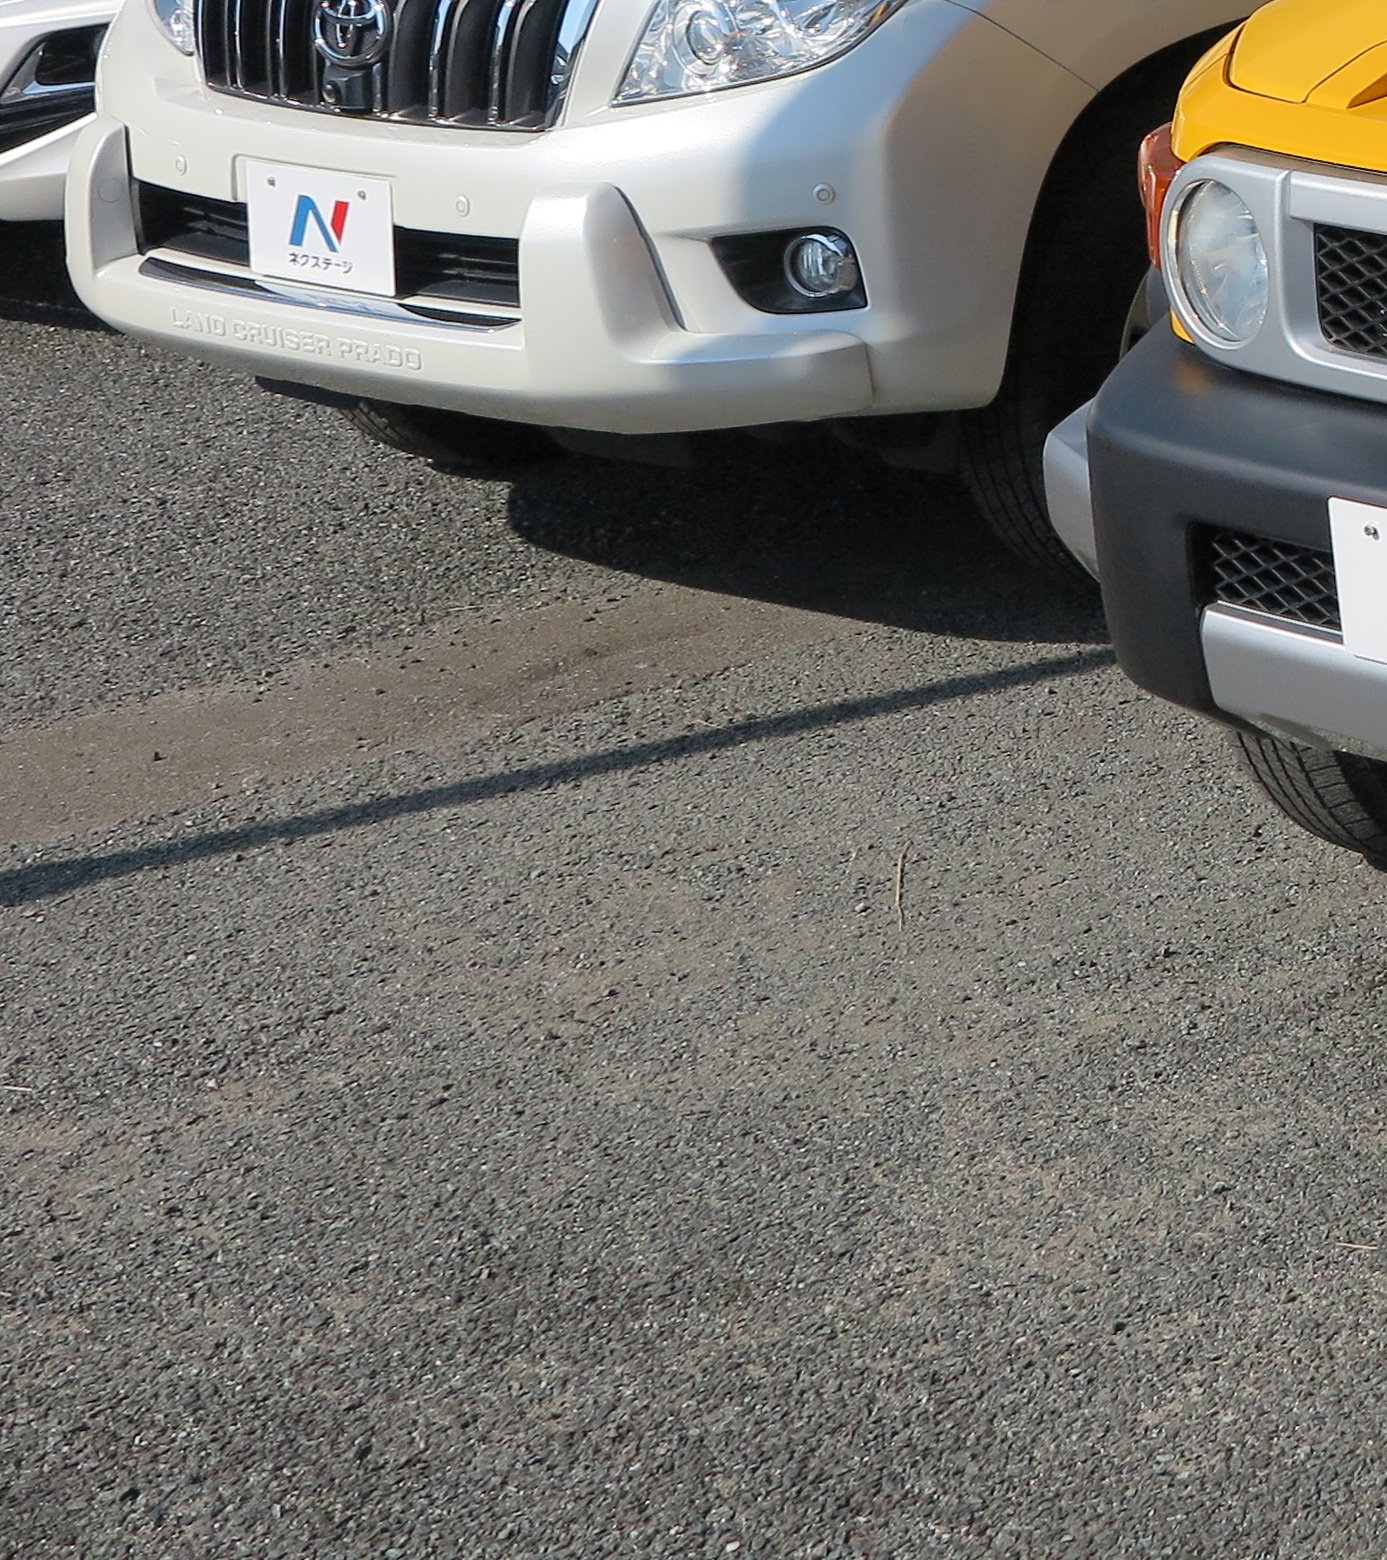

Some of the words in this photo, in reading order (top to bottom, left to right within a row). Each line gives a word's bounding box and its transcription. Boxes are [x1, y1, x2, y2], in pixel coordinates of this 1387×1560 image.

[288, 252, 353, 274] ネクステージ
[169, 307, 227, 337] LAND
[233, 319, 331, 356] CRUISER
[338, 336, 423, 371] PRADO
